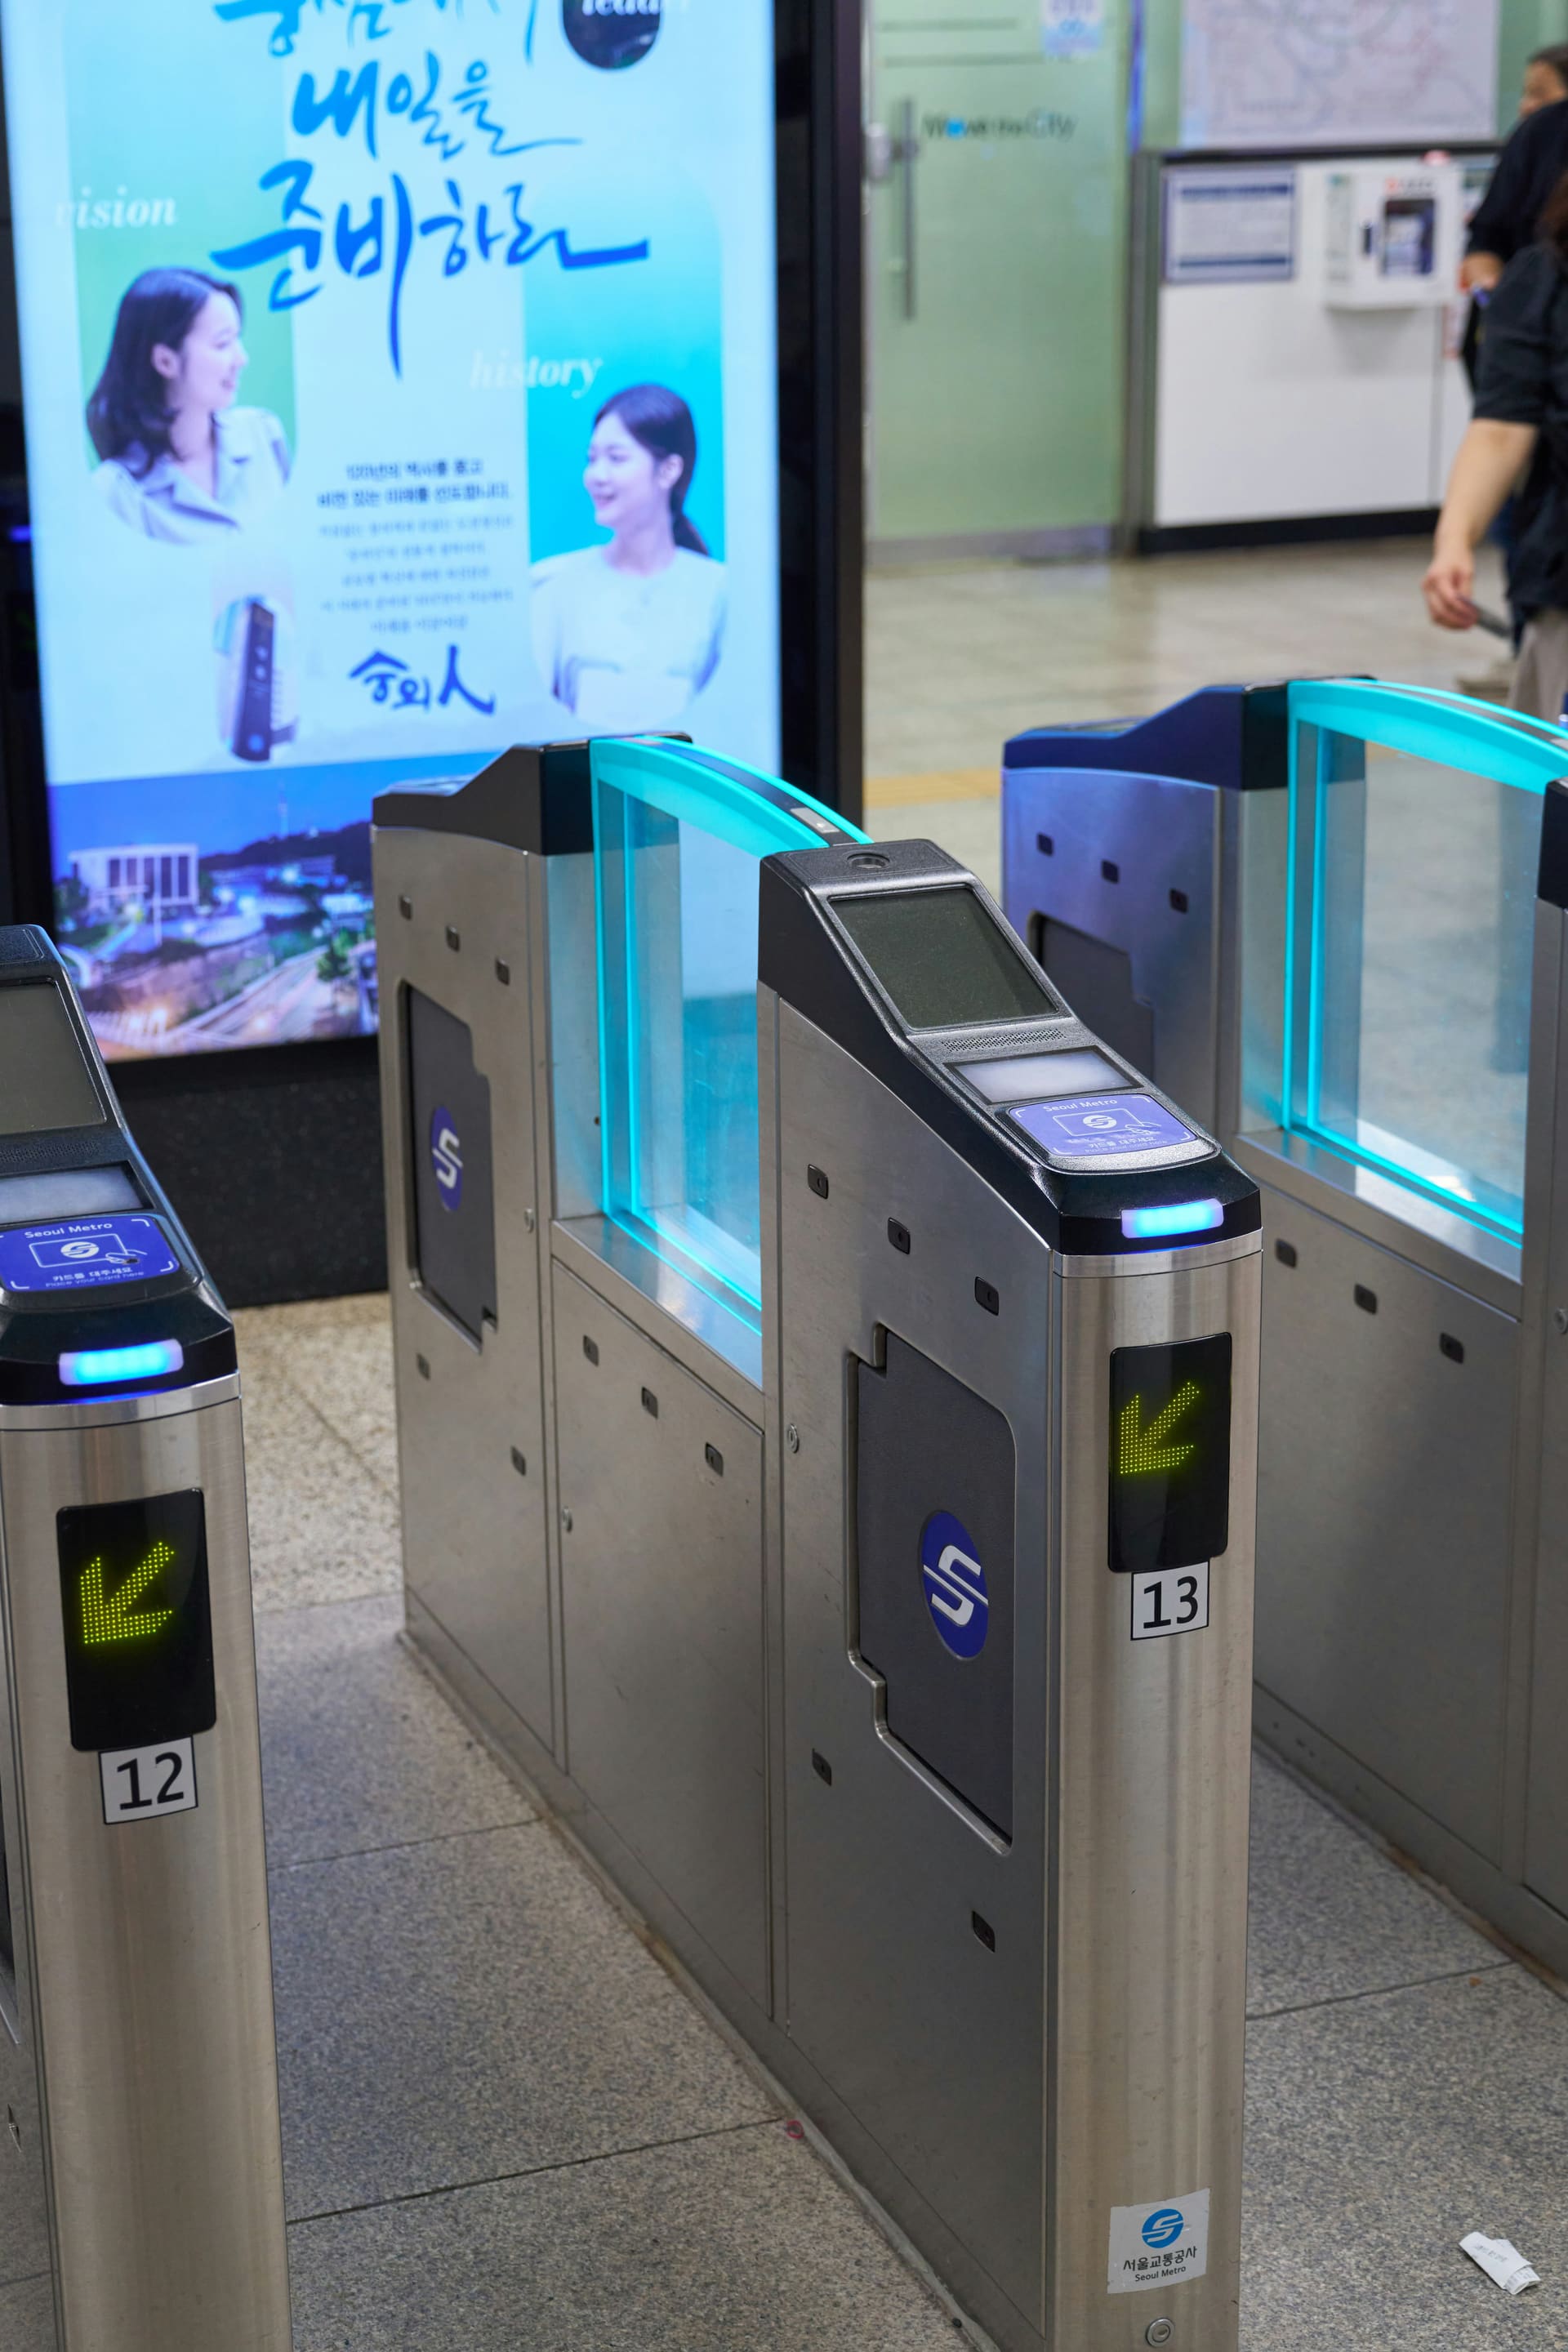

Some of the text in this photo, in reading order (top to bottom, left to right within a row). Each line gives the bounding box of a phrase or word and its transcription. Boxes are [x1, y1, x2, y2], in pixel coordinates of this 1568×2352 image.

[291, 50, 583, 161] 내일을
[54, 184, 178, 229] vision
[210, 160, 648, 380] 준비하라
[469, 348, 604, 399] history
[1043, 1099, 1118, 1112] Seoul Metro
[24, 1223, 113, 1239] Seoul Metro
[1143, 1575, 1198, 1629] 13
[117, 1751, 185, 1811] 12
[1123, 2246, 1197, 2271] 서울교통공사
[1134, 2265, 1187, 2282] Seoul Metro
